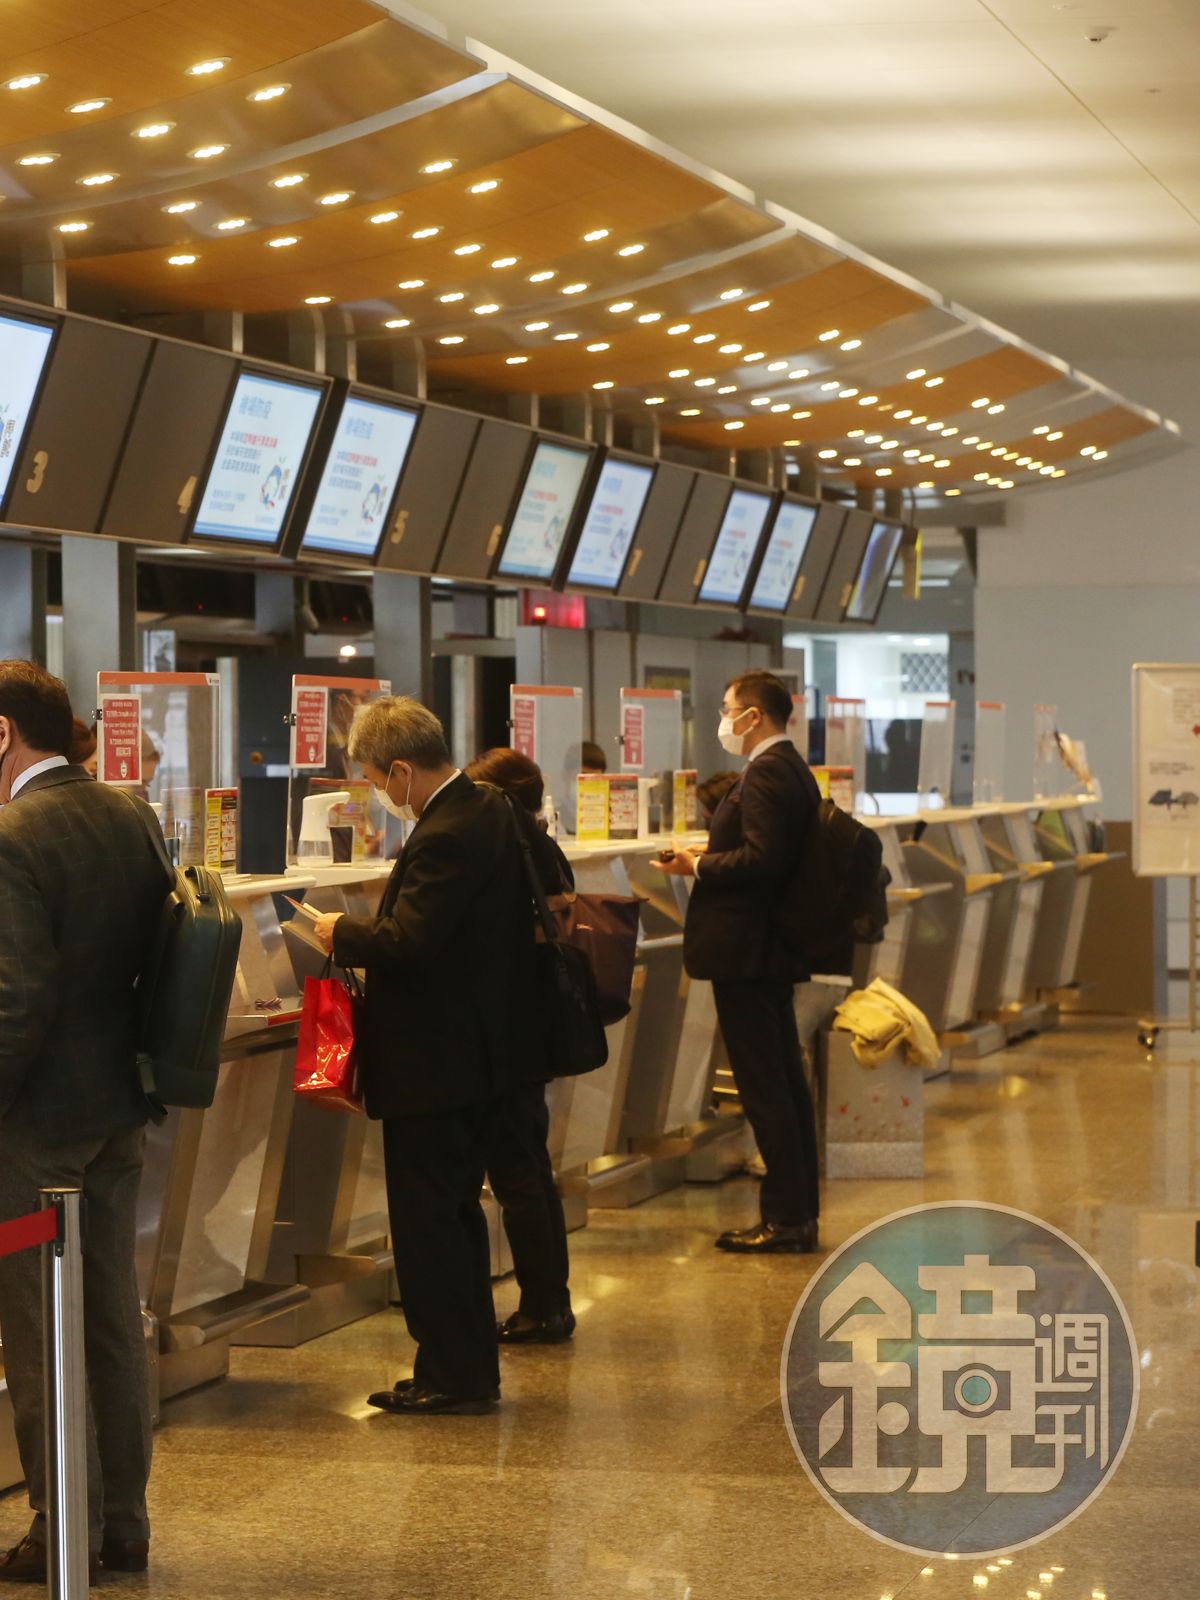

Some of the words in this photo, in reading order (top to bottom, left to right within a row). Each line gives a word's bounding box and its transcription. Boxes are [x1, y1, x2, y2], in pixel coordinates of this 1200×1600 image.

[26, 450, 49, 494] 3
[177, 476, 197, 514] 4
[391, 510, 409, 544] 5
